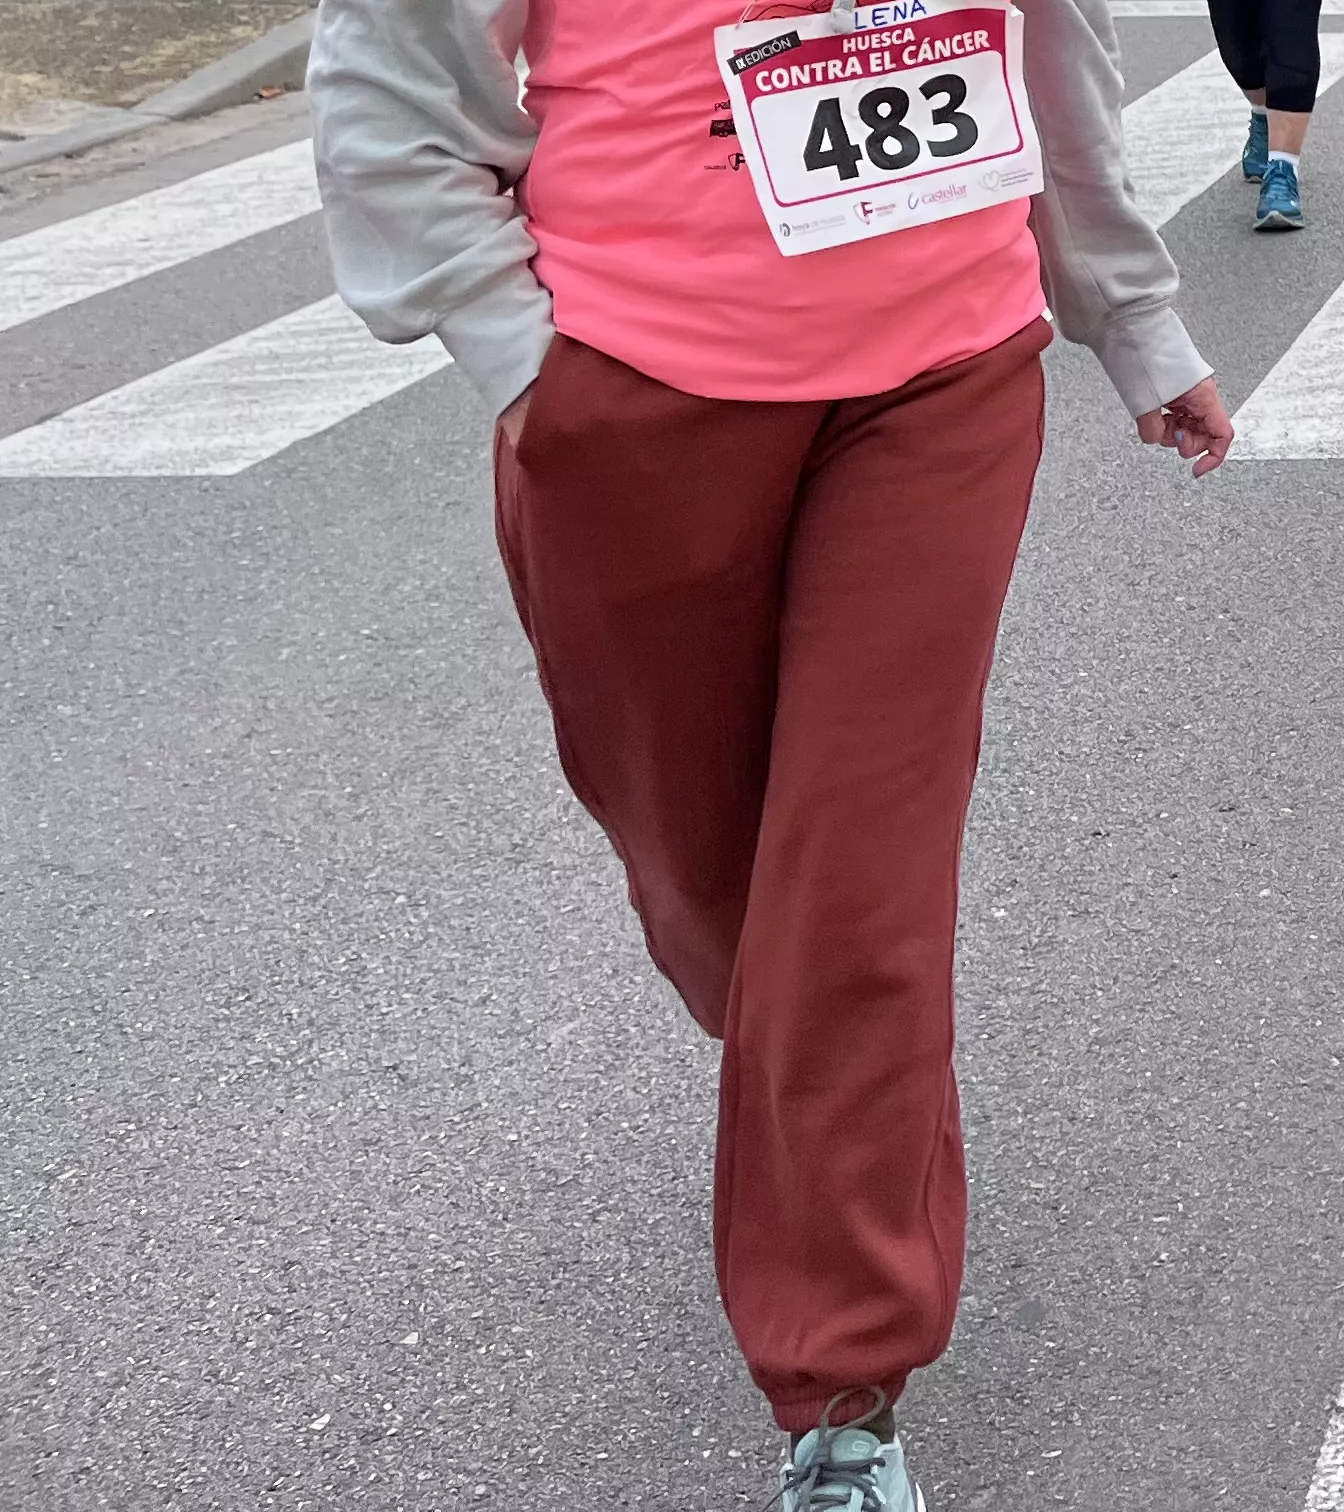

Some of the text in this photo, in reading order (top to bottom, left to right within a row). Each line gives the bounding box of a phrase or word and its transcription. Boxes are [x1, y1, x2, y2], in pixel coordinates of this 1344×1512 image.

[745, 37, 792, 65] EDICIÓN
[755, 29, 990, 92] CONTRA EL CÁNCER
[842, 27, 916, 54] HUESCA
[803, 73, 979, 181] 483
